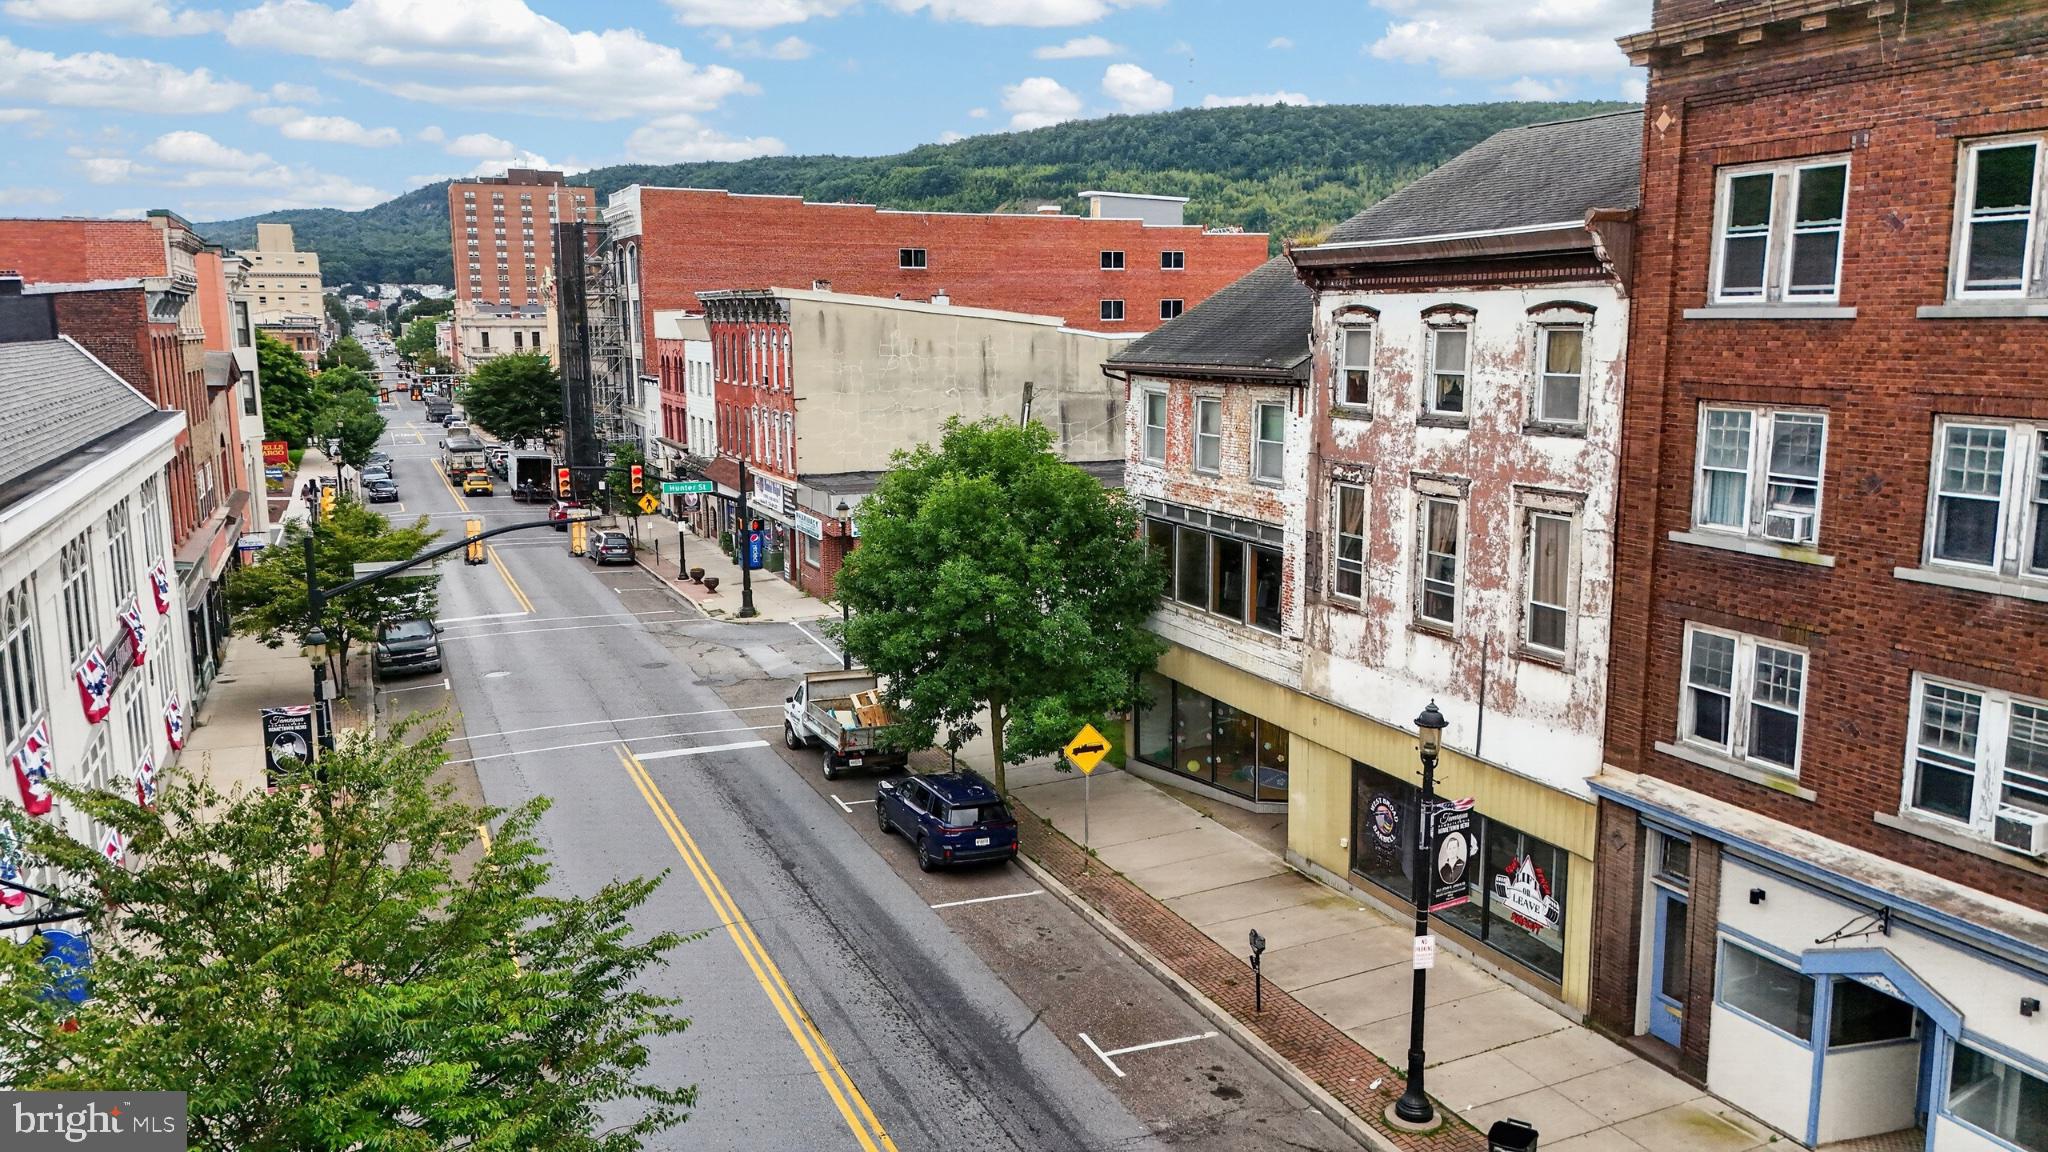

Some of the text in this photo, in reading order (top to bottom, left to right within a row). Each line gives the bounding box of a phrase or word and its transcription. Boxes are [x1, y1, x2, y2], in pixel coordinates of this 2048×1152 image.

[669, 483, 706, 492] Hunter St
[1370, 797, 1399, 823] WEST BROAD
[1515, 872, 1538, 891] LIFT
[1522, 887, 1531, 897] OR
[1512, 893, 1540, 914] LEAVE
